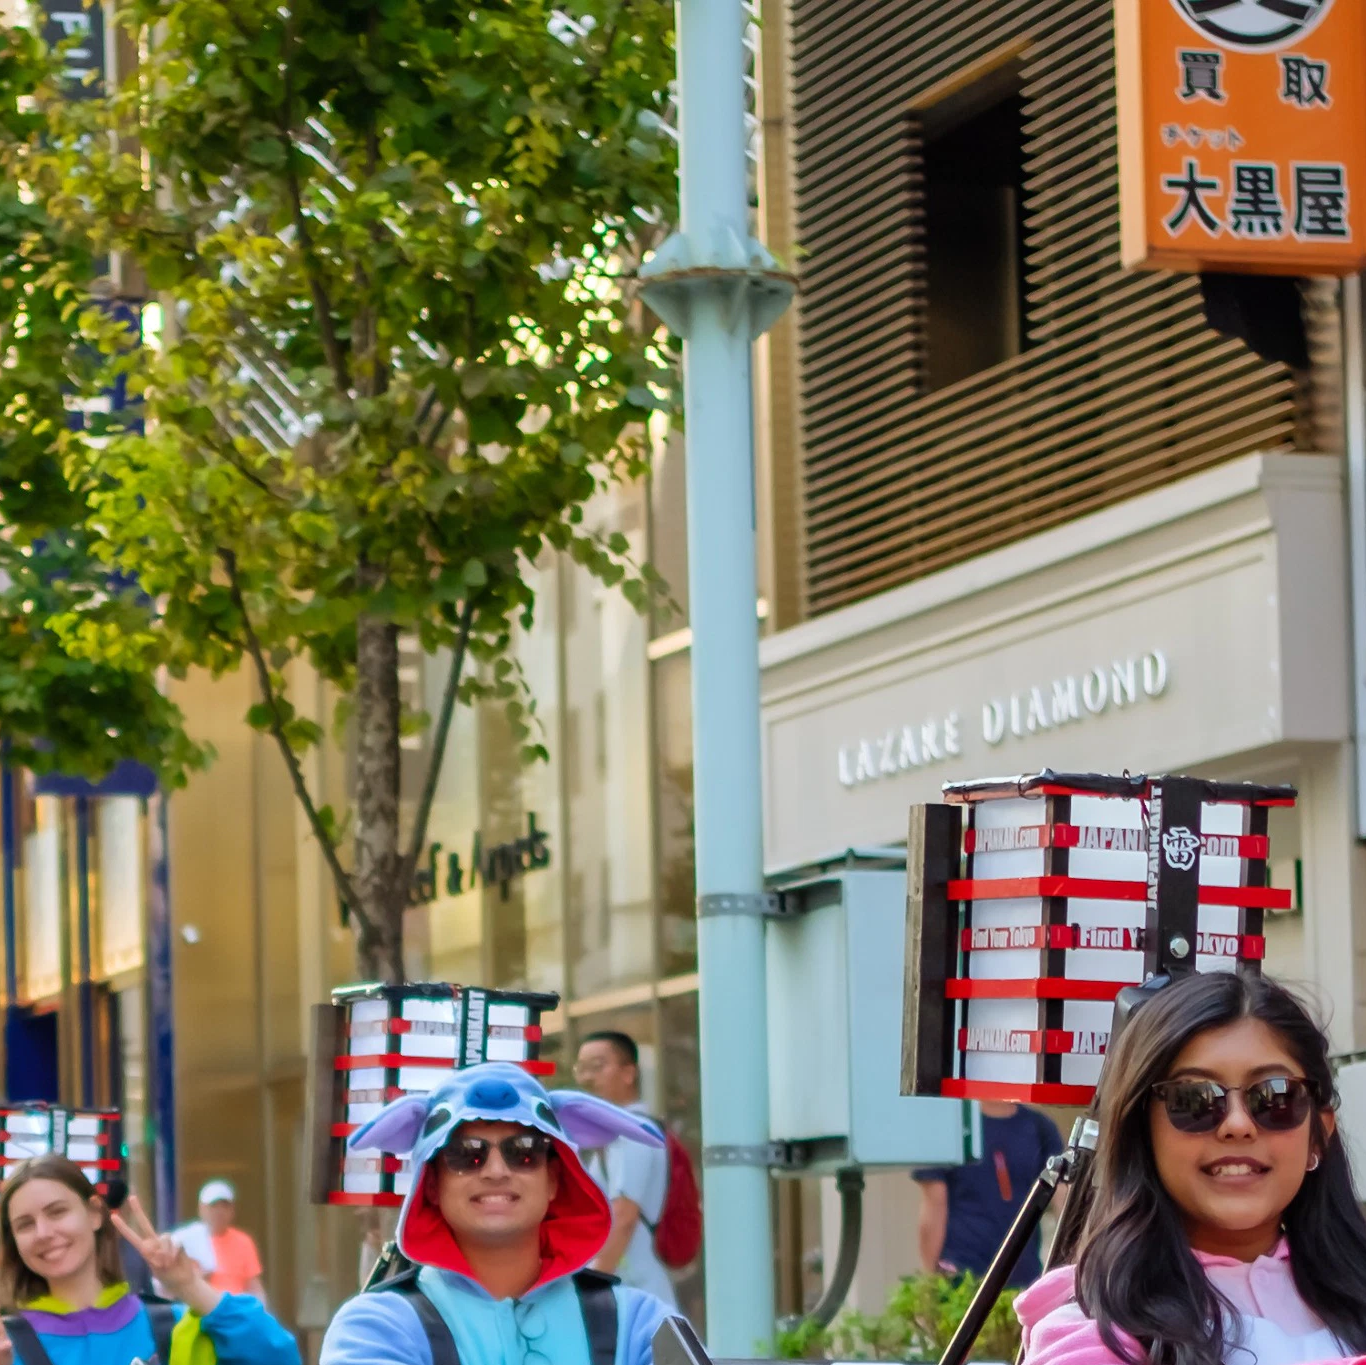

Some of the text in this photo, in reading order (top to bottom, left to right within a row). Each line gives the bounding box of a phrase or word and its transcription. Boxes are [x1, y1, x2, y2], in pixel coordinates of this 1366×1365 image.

[1161, 156, 1352, 243] 大黒屋
[983, 649, 1167, 745] DIAMOND
[1080, 926, 1125, 948] Find
